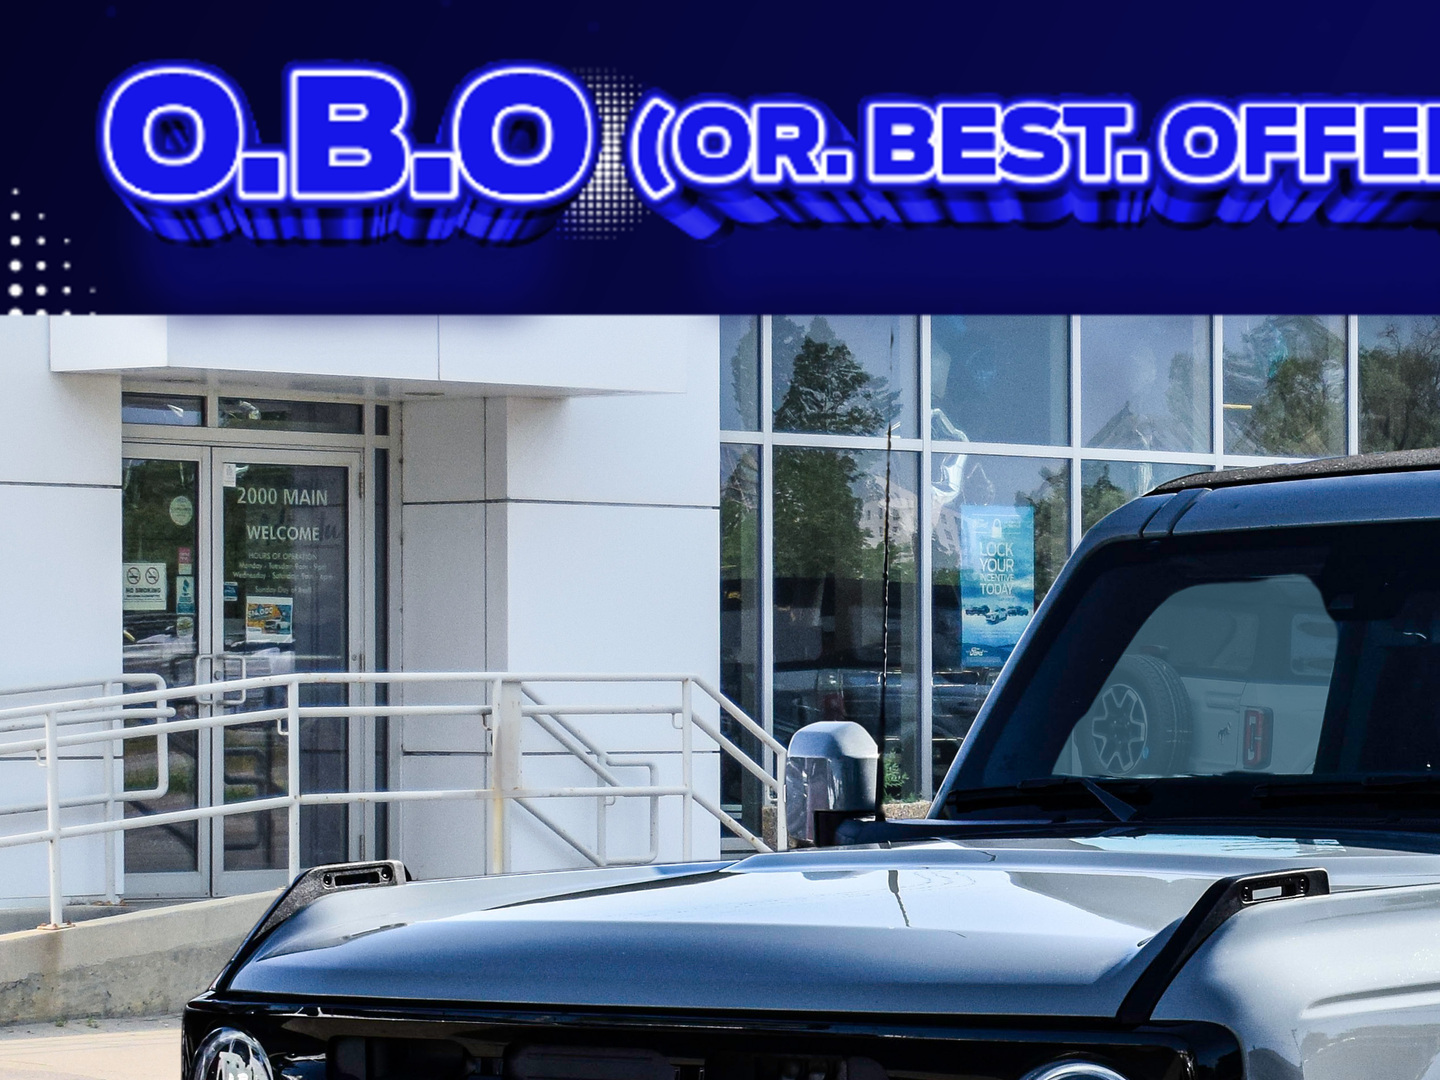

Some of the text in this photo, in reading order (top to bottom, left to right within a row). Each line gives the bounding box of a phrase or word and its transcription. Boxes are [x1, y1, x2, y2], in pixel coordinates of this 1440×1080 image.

[237, 487, 328, 506] 2000 MAIN
[247, 525, 320, 541] WELCOME
[980, 541, 1014, 556] LOCK
[248, 552, 271, 560] HOURS
[980, 558, 1014, 572] YOUR
[980, 583, 1013, 595] TODAY
